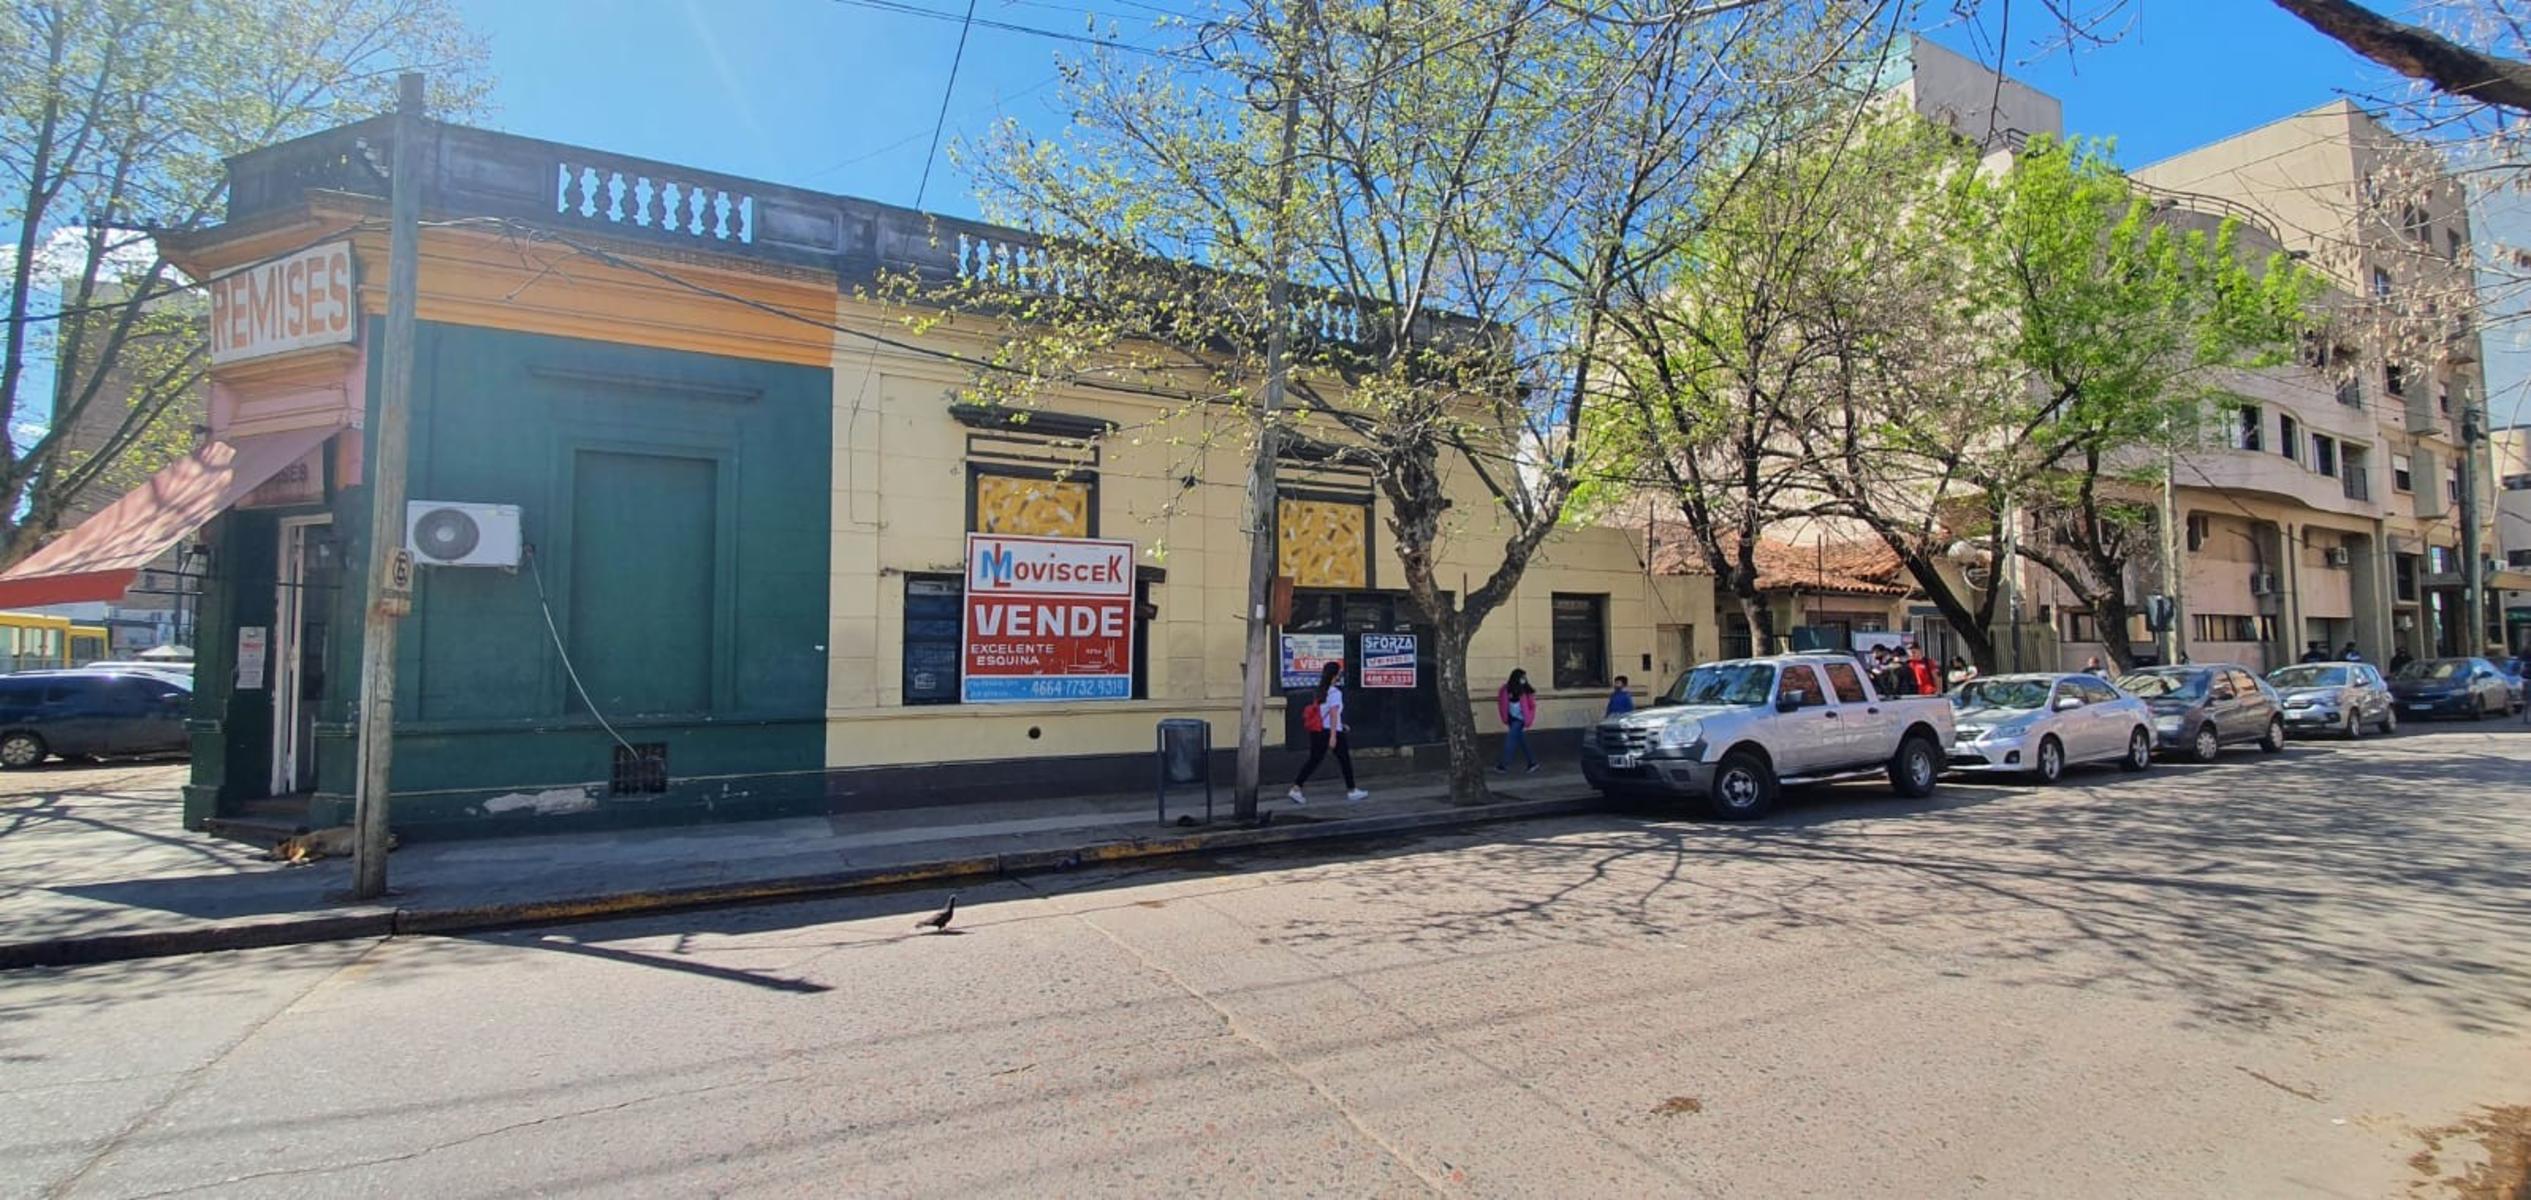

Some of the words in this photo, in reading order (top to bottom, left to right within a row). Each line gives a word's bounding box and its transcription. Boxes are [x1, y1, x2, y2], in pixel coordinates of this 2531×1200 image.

[212, 252, 349, 352] REMISES
[975, 604, 1124, 637] VENDE
[970, 643, 1056, 655] EXCELENTE
[1365, 635, 1413, 650] SFORZA
[976, 655, 1040, 666] ESQUINA
